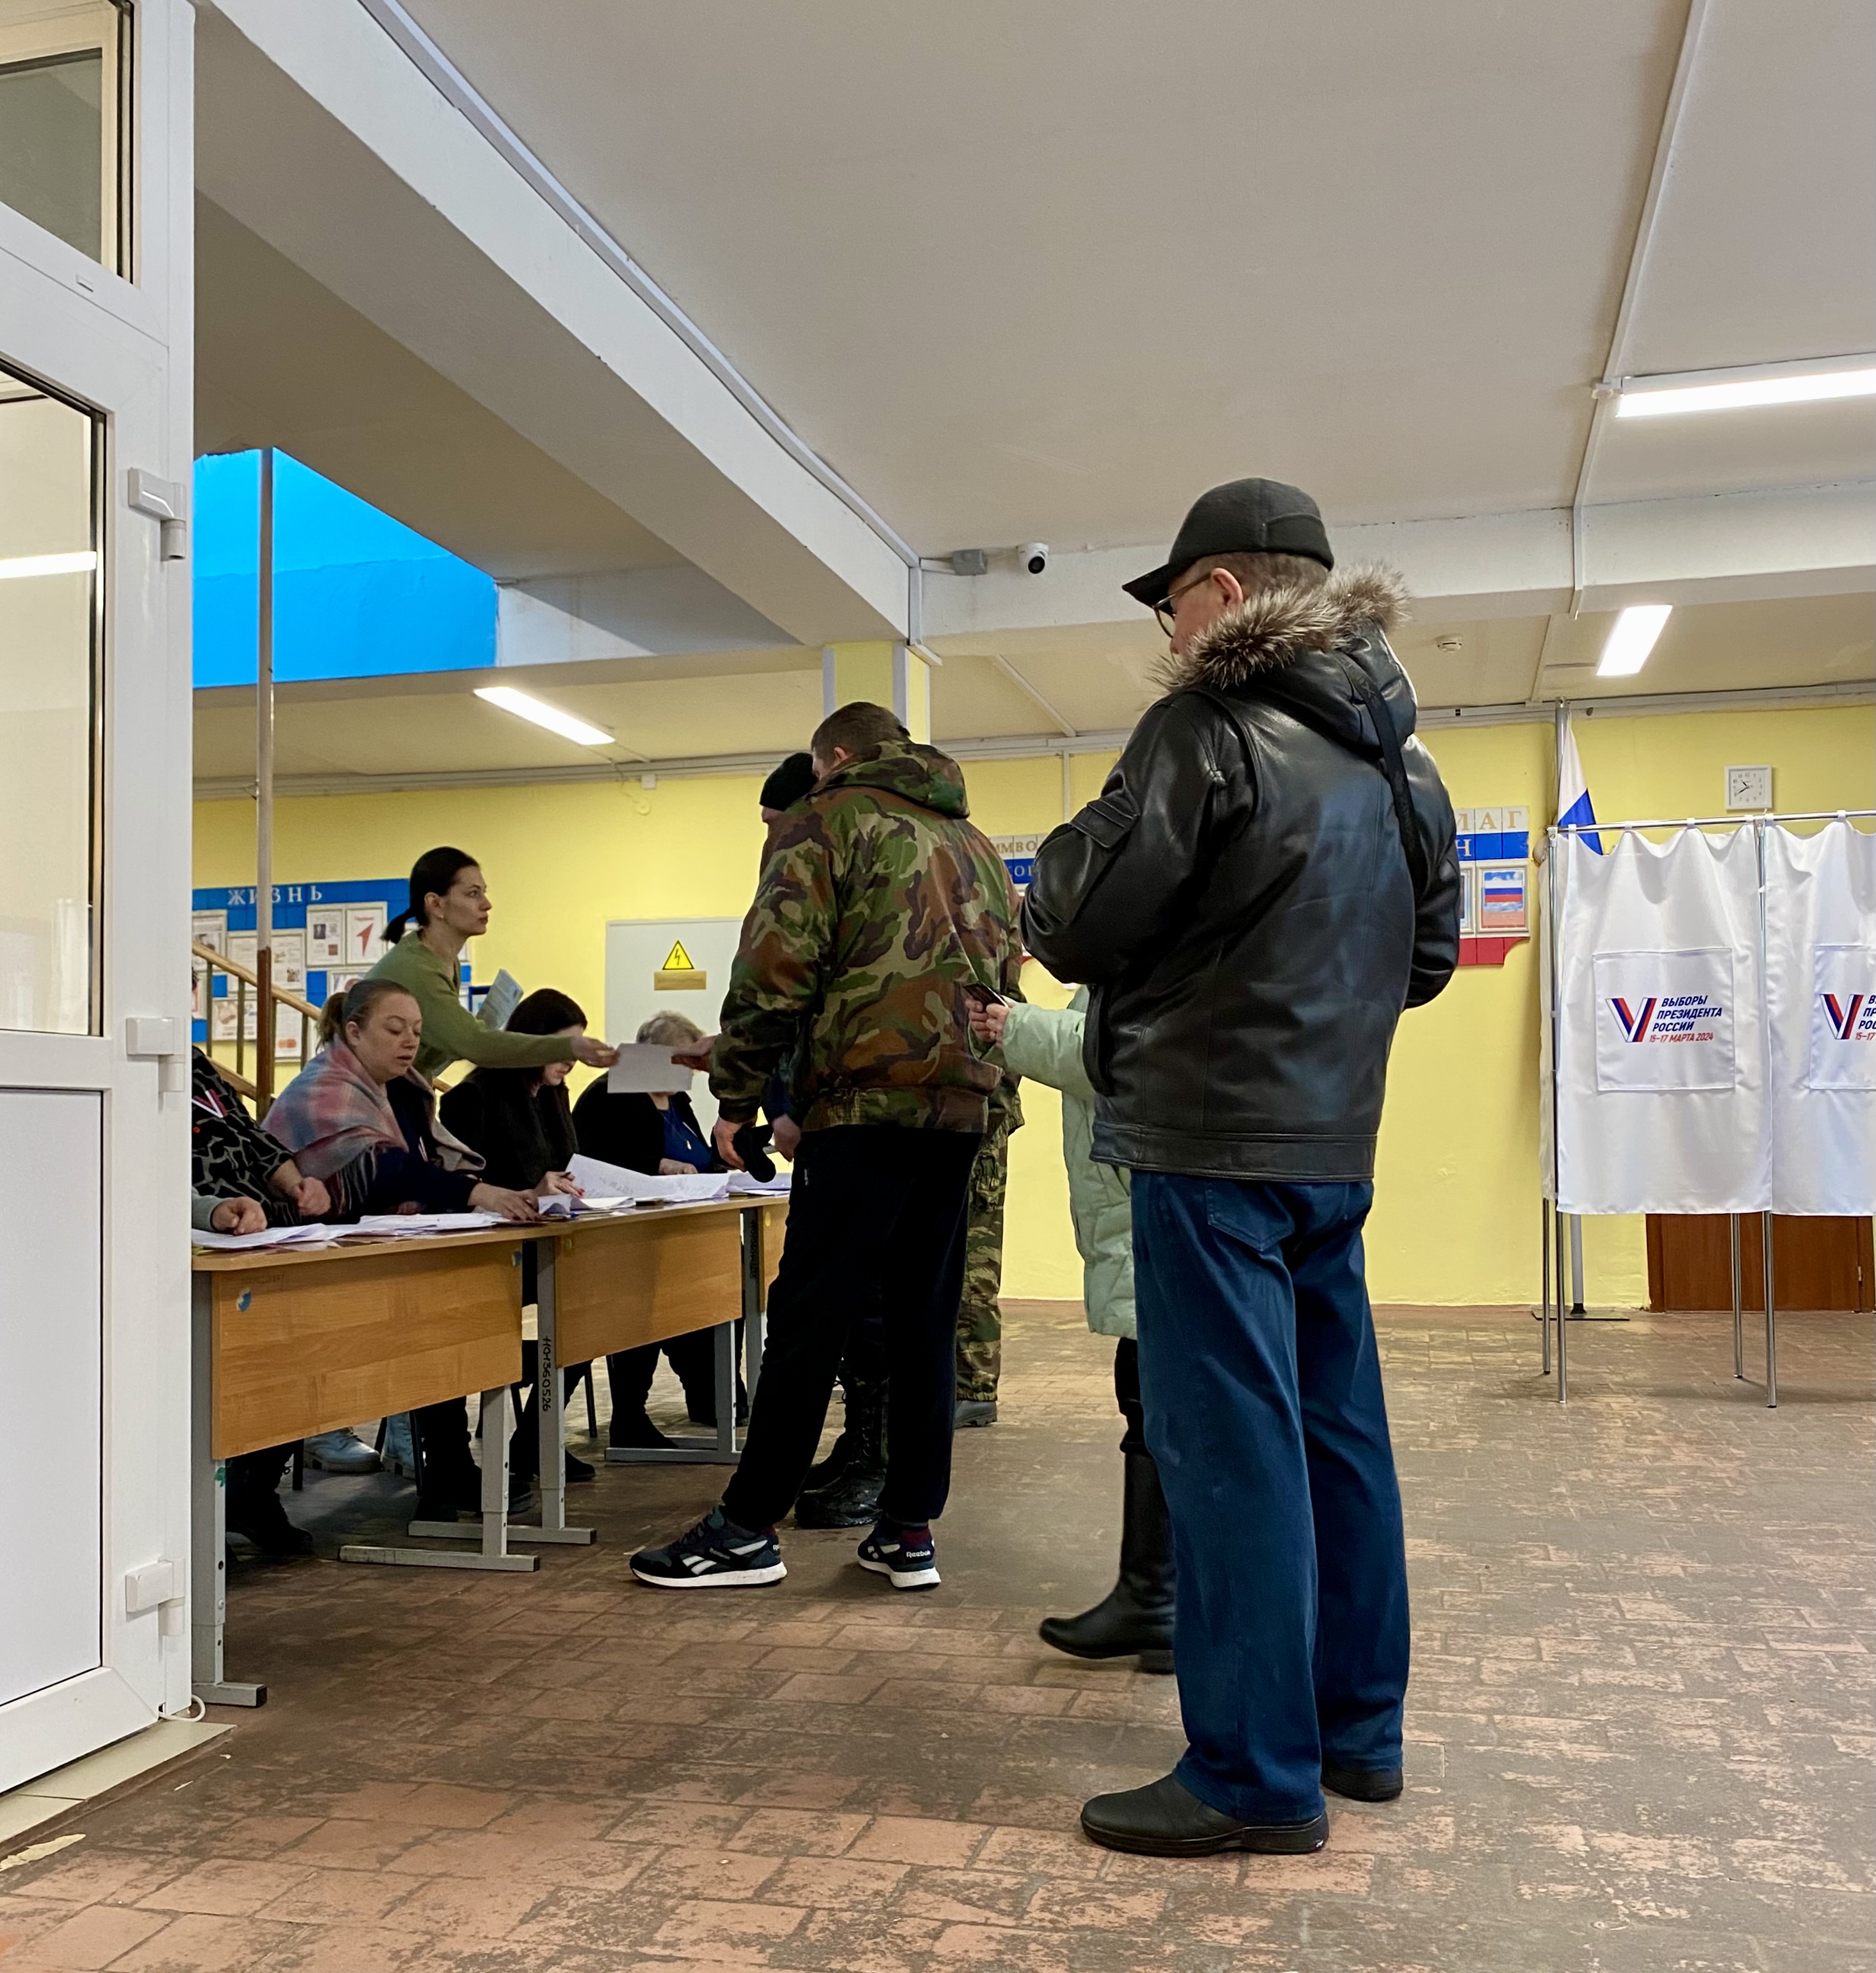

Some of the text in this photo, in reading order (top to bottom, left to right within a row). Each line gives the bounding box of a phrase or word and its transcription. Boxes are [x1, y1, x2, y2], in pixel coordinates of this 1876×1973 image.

[1661, 995, 1708, 1007] ВЫБОРЫ
[1657, 1008, 1723, 1020] ПРЕЗИДЕНТА
[1652, 1021, 1695, 1032] РОССИИ
[1669, 1033, 1695, 1043] МАРТА
[1696, 1033, 1714, 1042] 2024
